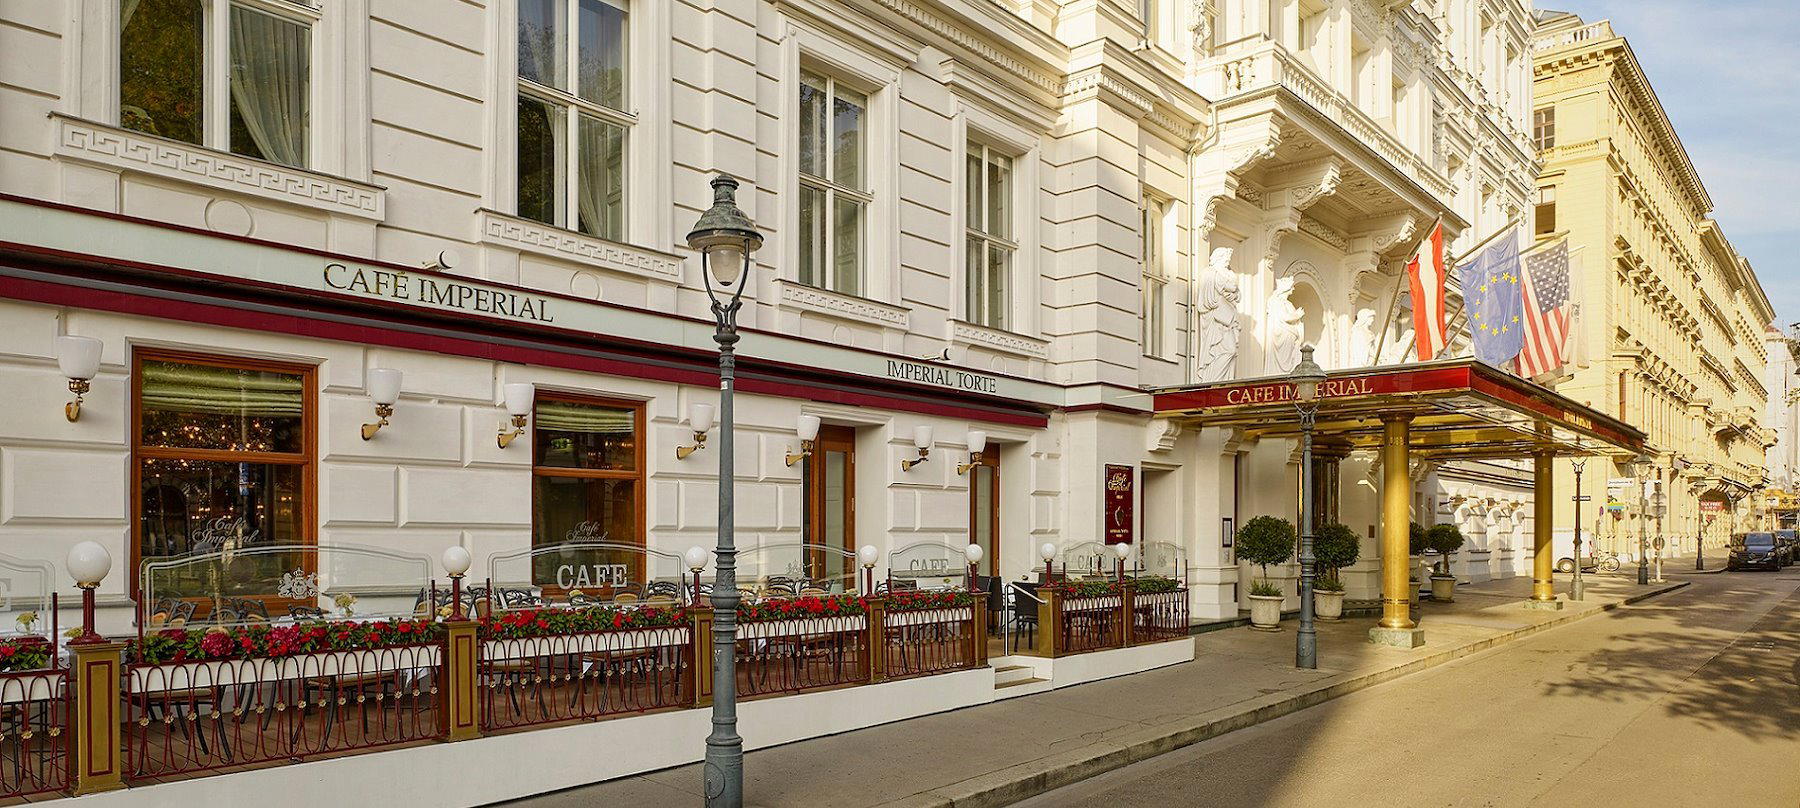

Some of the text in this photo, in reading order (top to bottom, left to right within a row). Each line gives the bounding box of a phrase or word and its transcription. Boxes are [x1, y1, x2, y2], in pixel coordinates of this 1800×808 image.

[323, 263, 554, 323] CAFÉ IMPERIAL
[886, 360, 997, 393] IMPERIAL TORTE
[1227, 378, 1373, 404] CAFE IMERIAL
[206, 516, 248, 536] Café
[556, 564, 628, 590] CAFE
[910, 558, 949, 574] CAFE
